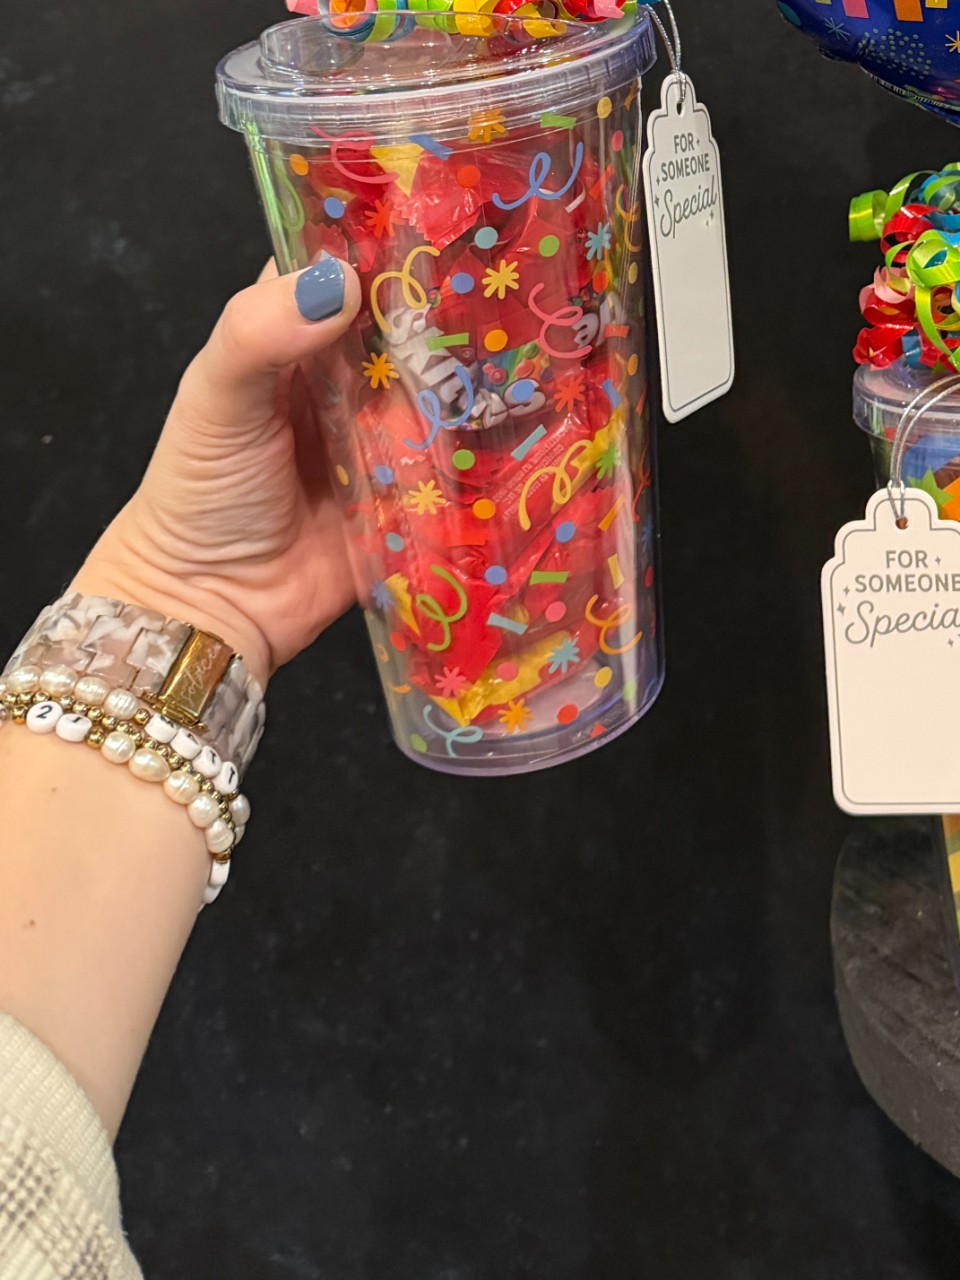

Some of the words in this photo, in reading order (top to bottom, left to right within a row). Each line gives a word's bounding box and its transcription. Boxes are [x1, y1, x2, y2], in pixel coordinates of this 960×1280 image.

[673, 132, 696, 154] FOR
[661, 153, 710, 183] SOMEONE
[660, 175, 717, 239] Special
[885, 550, 928, 568] FOR
